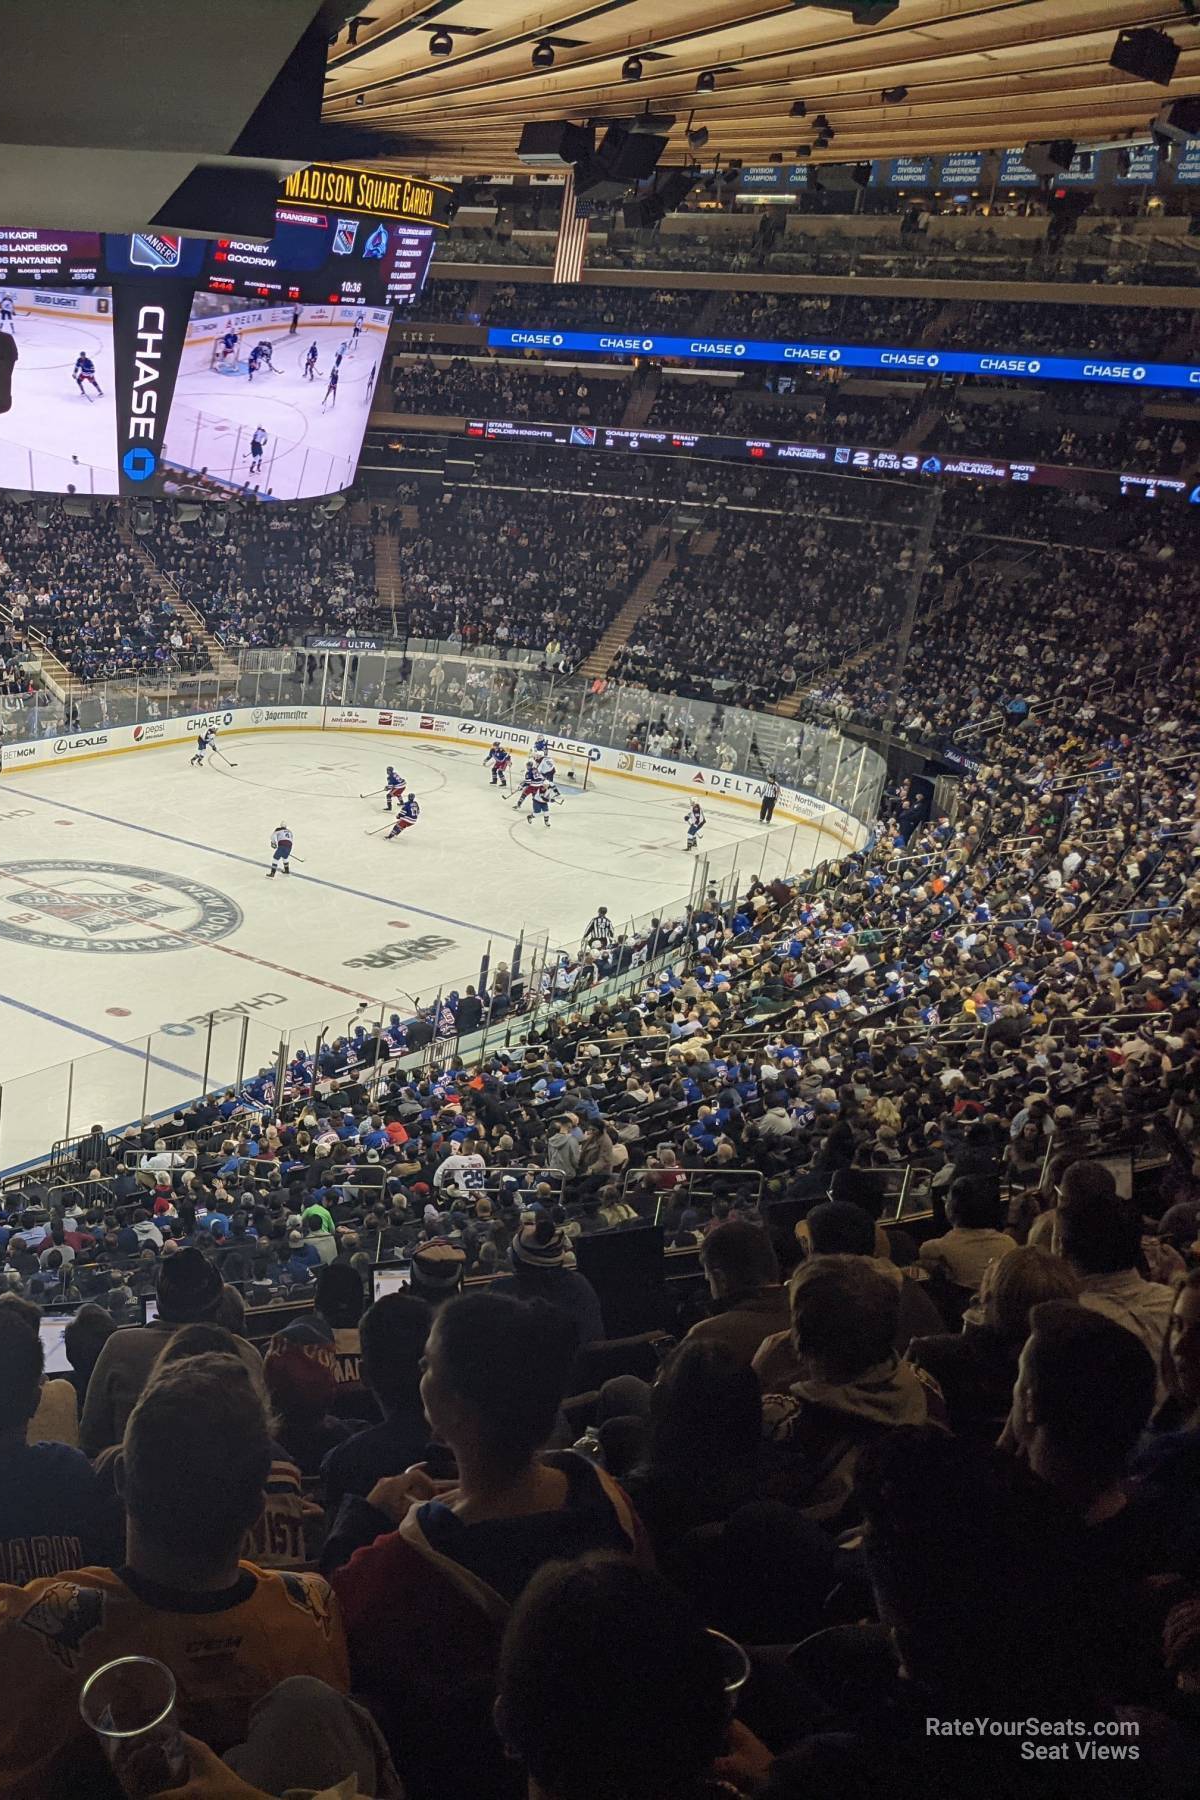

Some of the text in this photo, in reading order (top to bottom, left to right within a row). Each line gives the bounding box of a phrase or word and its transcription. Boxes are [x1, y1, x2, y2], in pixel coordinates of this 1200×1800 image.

[892, 174, 926, 182] CHAMPIONS
[285, 166, 434, 216] MADISON SQUARE GARDEN
[280, 212, 318, 224] RANGERS
[8, 232, 38, 240] KADRI
[9, 244, 68, 252] LANDESKOG
[230, 242, 270, 254] ROONEY
[10, 256, 62, 264] RANTANEN
[227, 253, 276, 268] GOODROW
[341, 281, 362, 292] 10:36
[52, 297, 78, 308] LIGHT
[234, 313, 262, 324] DELTA
[512, 334, 550, 344] CHASE
[600, 338, 640, 350] CHASE
[690, 343, 732, 354] CHASE
[784, 348, 827, 360] CHASE
[880, 354, 925, 365] CHASE
[980, 359, 1026, 371] CHASE
[128, 306, 166, 440] CHASE
[1083, 365, 1130, 378] CHASE
[488, 428, 519, 436] GOLDEN
[672, 434, 698, 442] PENALTY
[746, 440, 772, 448] SHOTS
[778, 448, 826, 460] RANGERS
[852, 452, 870, 465] 2
[872, 459, 900, 470] 10:36
[901, 456, 918, 470] 3
[1010, 464, 1036, 472] SHOTS
[944, 464, 1004, 476] AVALANCHE
[1012, 472, 1029, 481] 23
[1120, 476, 1146, 484] GOALS
[1157, 480, 1186, 488] PERIOD
[348, 640, 376, 648] ULTRA
[145, 724, 166, 734] pepsi
[186, 715, 221, 731] CHASE
[479, 726, 530, 745] HYUNDAI
[66, 736, 108, 750] LEXUS
[4, 748, 36, 760] BETMGM
[636, 758, 676, 776] BETMGM
[710, 774, 764, 796] DELTA
[794, 794, 826, 812] Northwell
[792, 804, 813, 817] Health
[28, 886, 231, 950] NEW YORK RANGERS
[463, 1170, 483, 1189] 29
